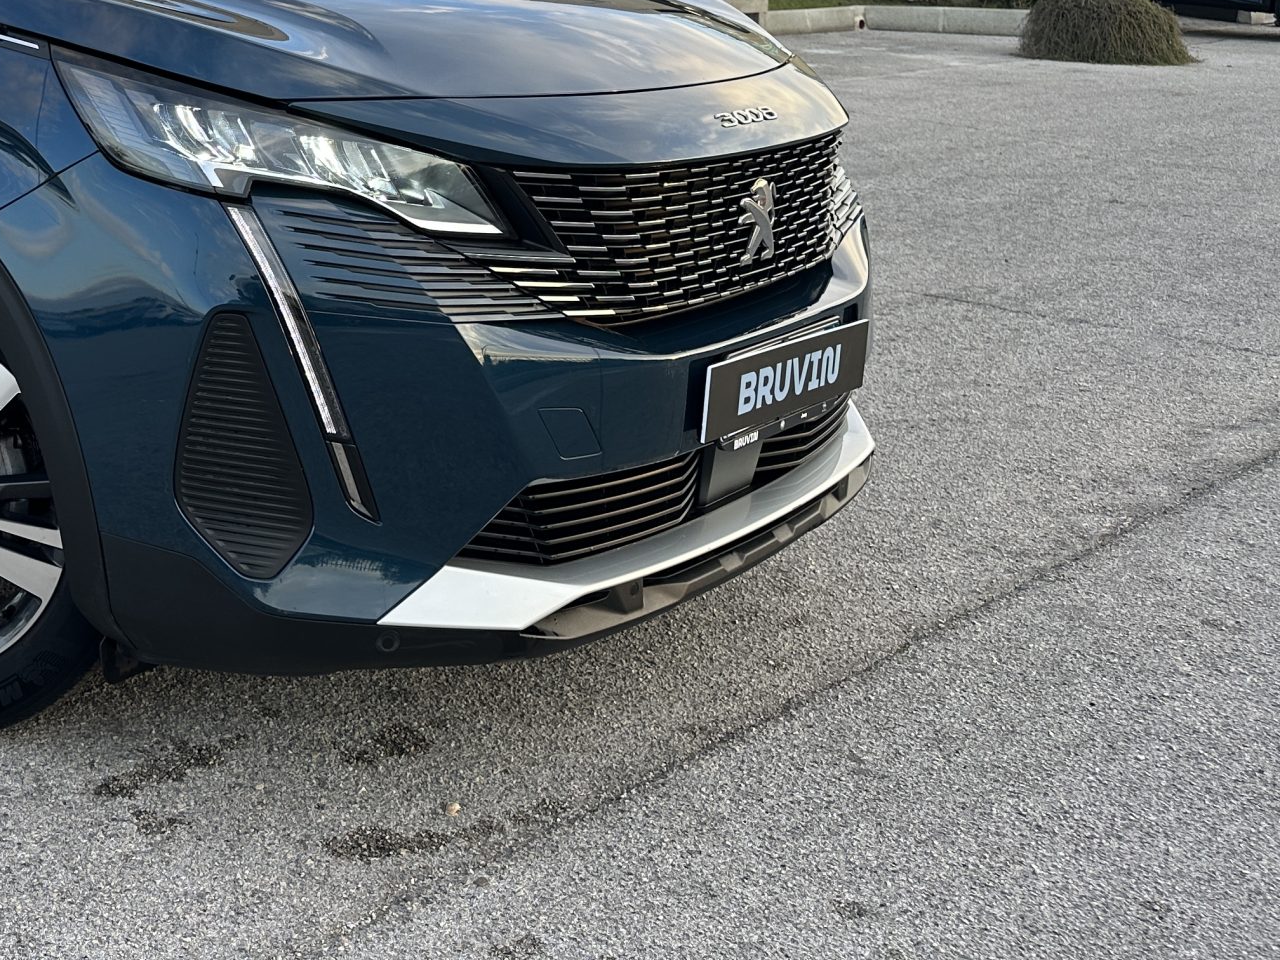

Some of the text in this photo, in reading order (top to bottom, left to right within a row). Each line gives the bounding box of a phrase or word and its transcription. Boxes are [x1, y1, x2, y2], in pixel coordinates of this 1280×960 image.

[713, 106, 778, 128] 3008
[737, 344, 842, 417] BRUVIN
[733, 430, 759, 451] BRUVIN
